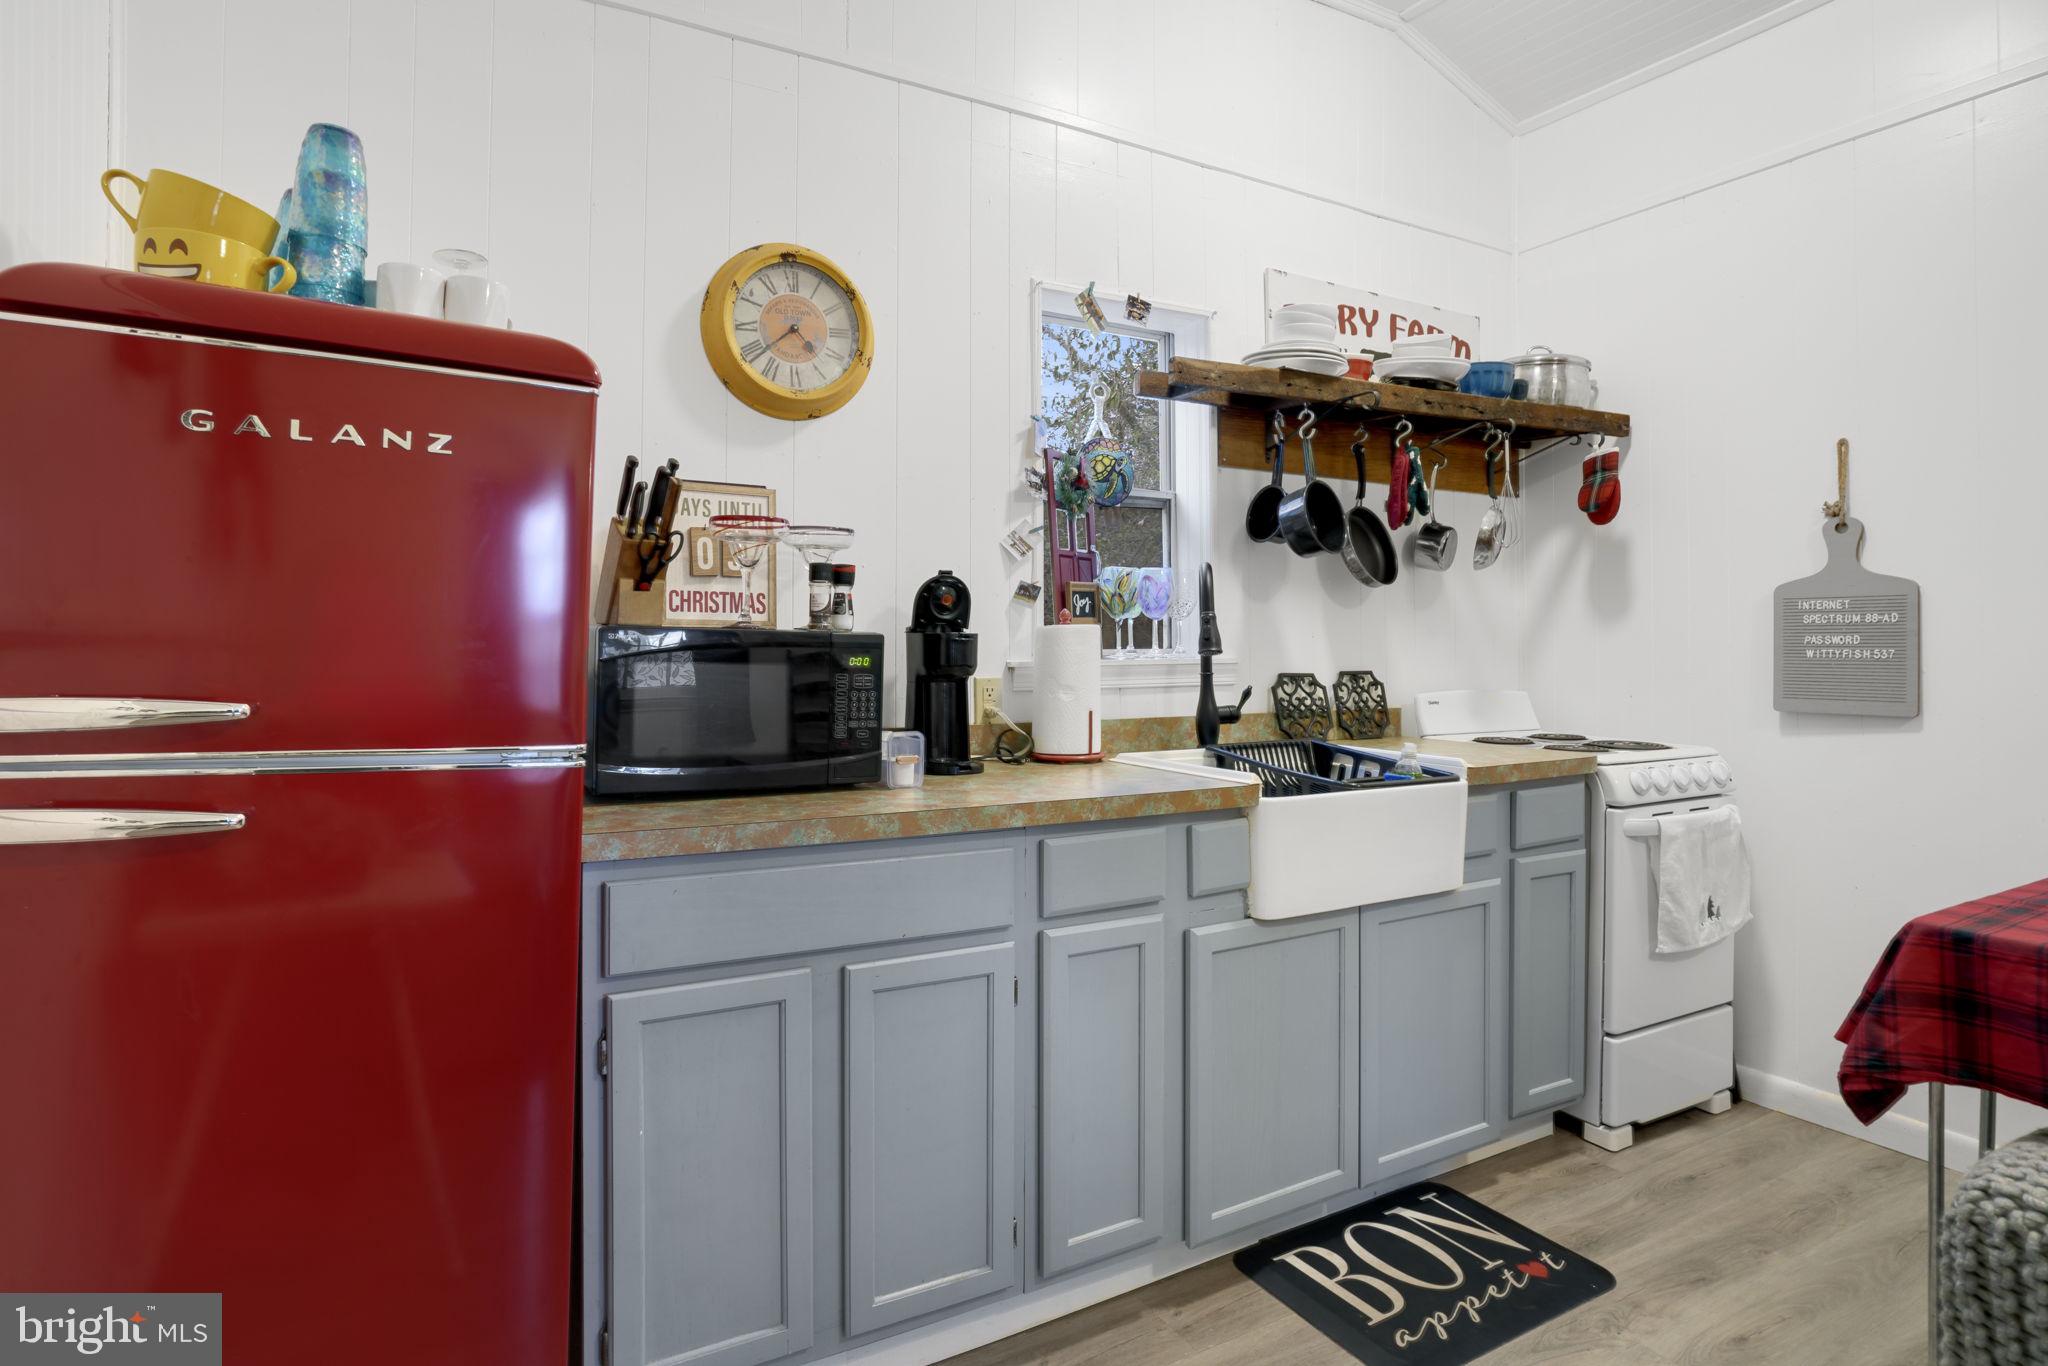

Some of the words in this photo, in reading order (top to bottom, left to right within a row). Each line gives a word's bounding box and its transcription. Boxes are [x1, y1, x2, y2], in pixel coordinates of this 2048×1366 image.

[181, 409, 452, 454] GALANZ
[680, 497, 711, 517] AYS
[668, 589, 767, 615] CHRISTMAS
[1073, 594, 1092, 616] Joy
[1798, 599, 1850, 610] INTERNET
[1802, 613, 1861, 624] SPECTRUM
[1803, 634, 1861, 645] PASSWORD
[849, 656, 870, 666] 0:00
[1272, 1192, 1532, 1327] BON
[1395, 1251, 1567, 1348] appett
